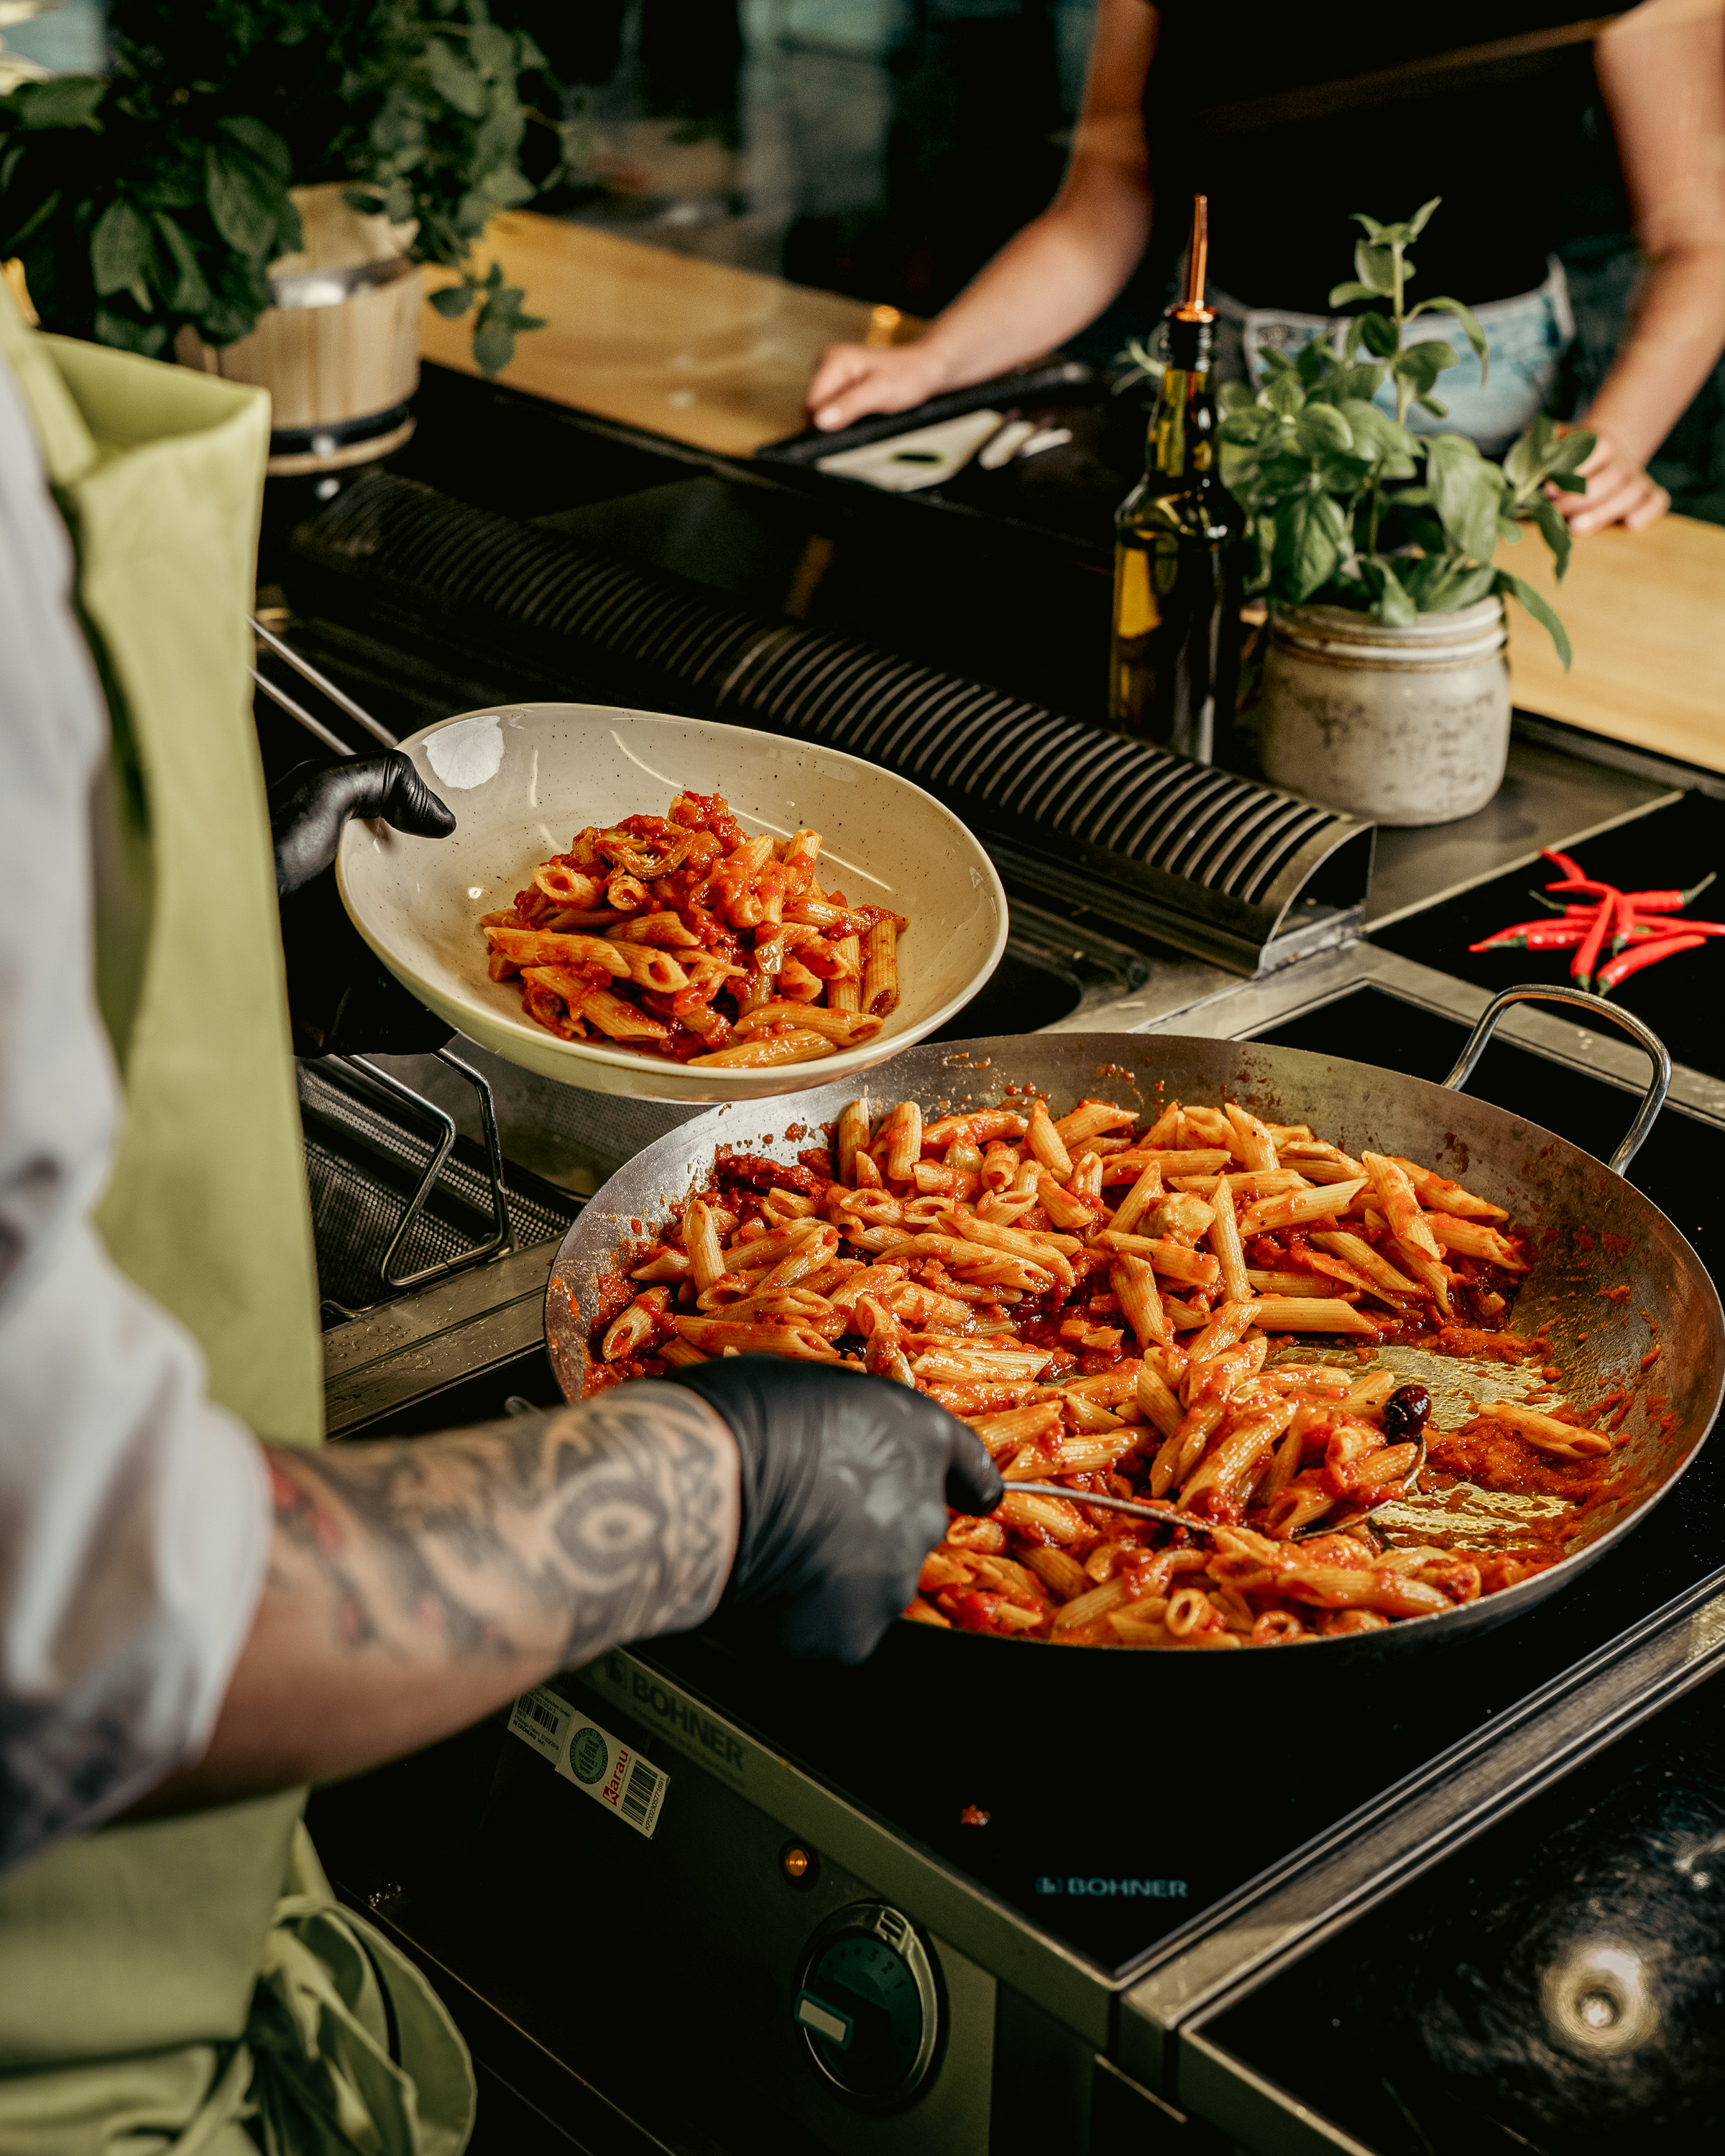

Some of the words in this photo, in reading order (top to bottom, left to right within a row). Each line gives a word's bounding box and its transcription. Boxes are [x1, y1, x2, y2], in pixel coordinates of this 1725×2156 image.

[518, 1723, 536, 1740] ORDNUNG
[632, 1670, 744, 1772] BOHNER
[644, 1777, 666, 1831] KP202305771691
[1067, 1876, 1189, 1898] BOHNER
[868, 1948, 879, 1963] 3
[880, 1961, 894, 1975] 2
[893, 1979, 906, 1990] 1
